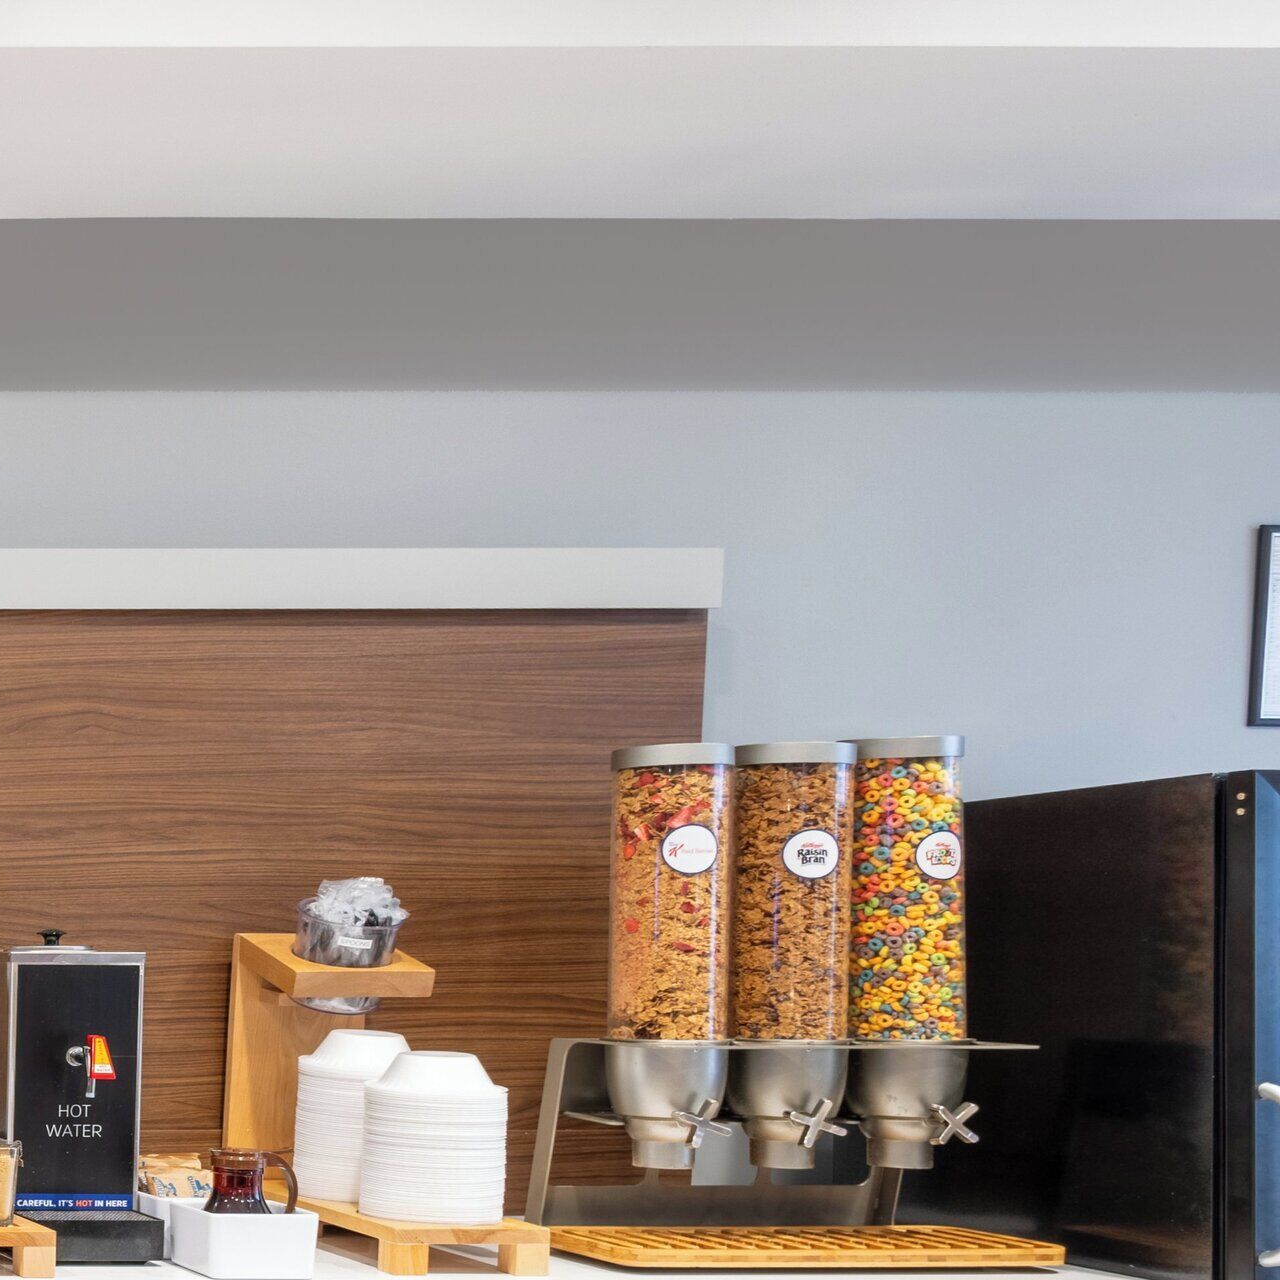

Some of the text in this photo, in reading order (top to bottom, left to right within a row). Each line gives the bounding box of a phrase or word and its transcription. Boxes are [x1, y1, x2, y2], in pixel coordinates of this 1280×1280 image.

[797, 848, 828, 857] Raisin
[801, 855, 825, 865] Bran
[58, 1104, 92, 1118] HOT
[45, 1124, 103, 1138] WATER
[16, 1199, 128, 1208] CAREFUL, IT'S HOT IN HERE
